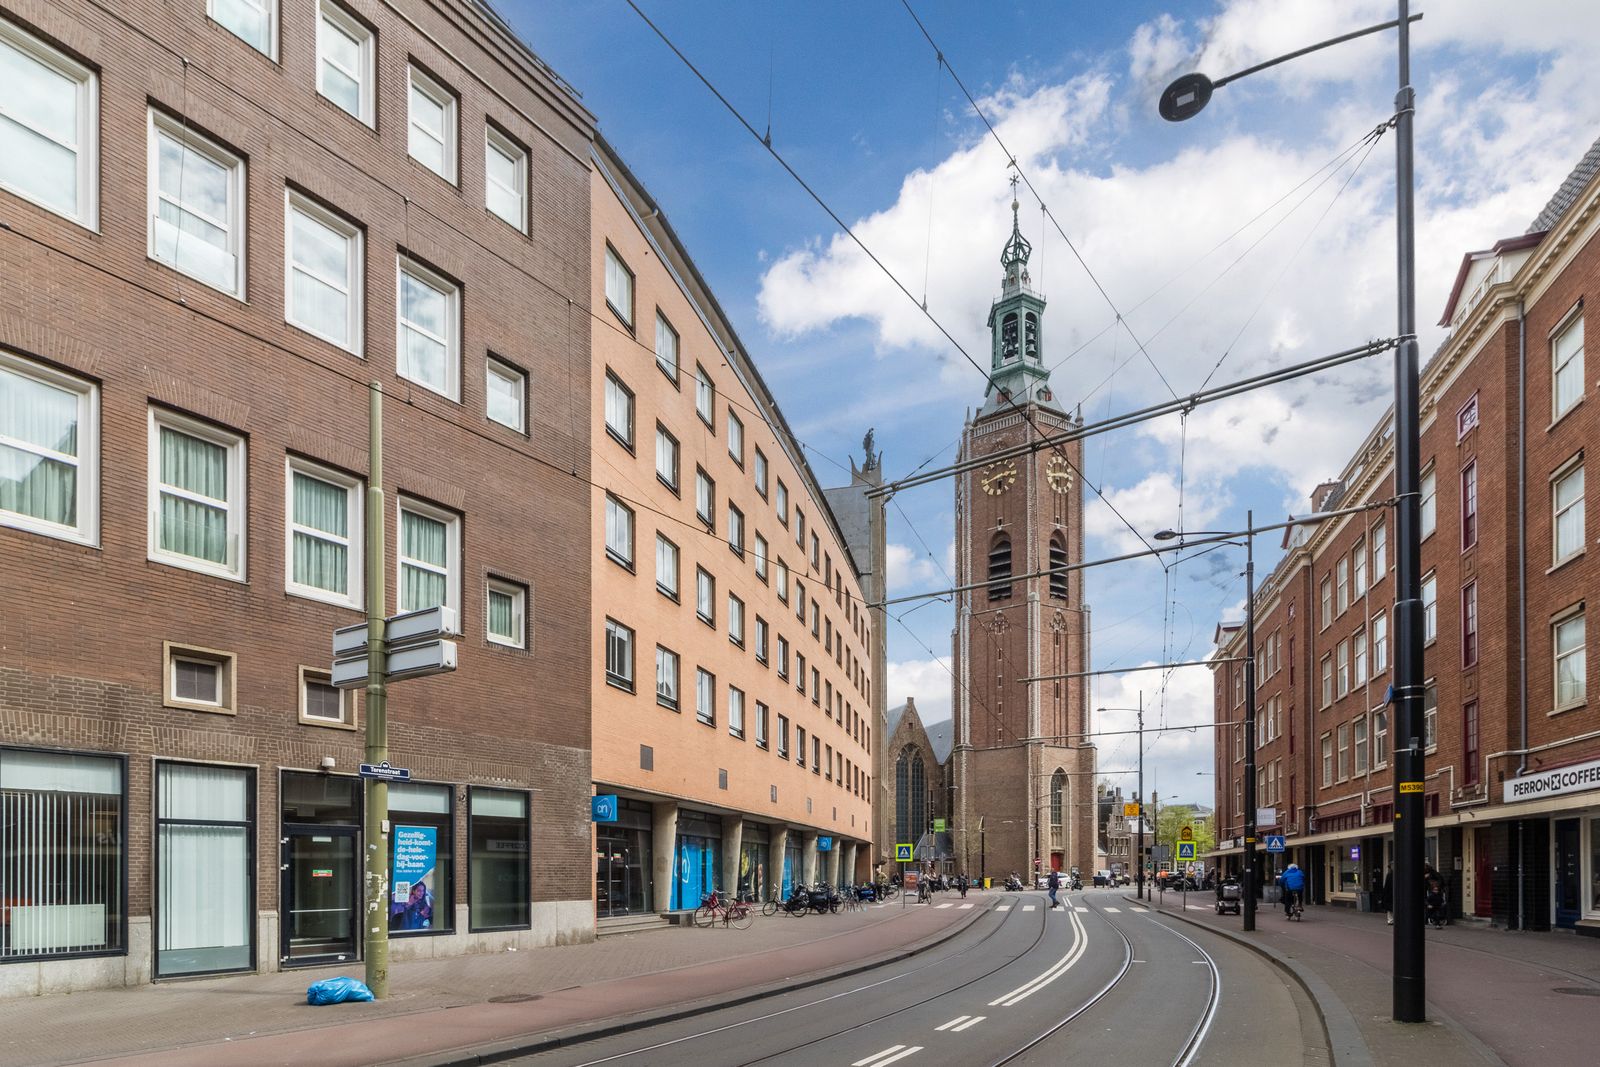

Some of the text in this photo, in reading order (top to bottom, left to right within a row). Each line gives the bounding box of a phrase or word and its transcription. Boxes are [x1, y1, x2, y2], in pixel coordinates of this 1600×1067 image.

[370, 766, 401, 775] Torenstraat
[1513, 777, 1550, 796] PERRON
[1562, 766, 1600, 787] COFFEE
